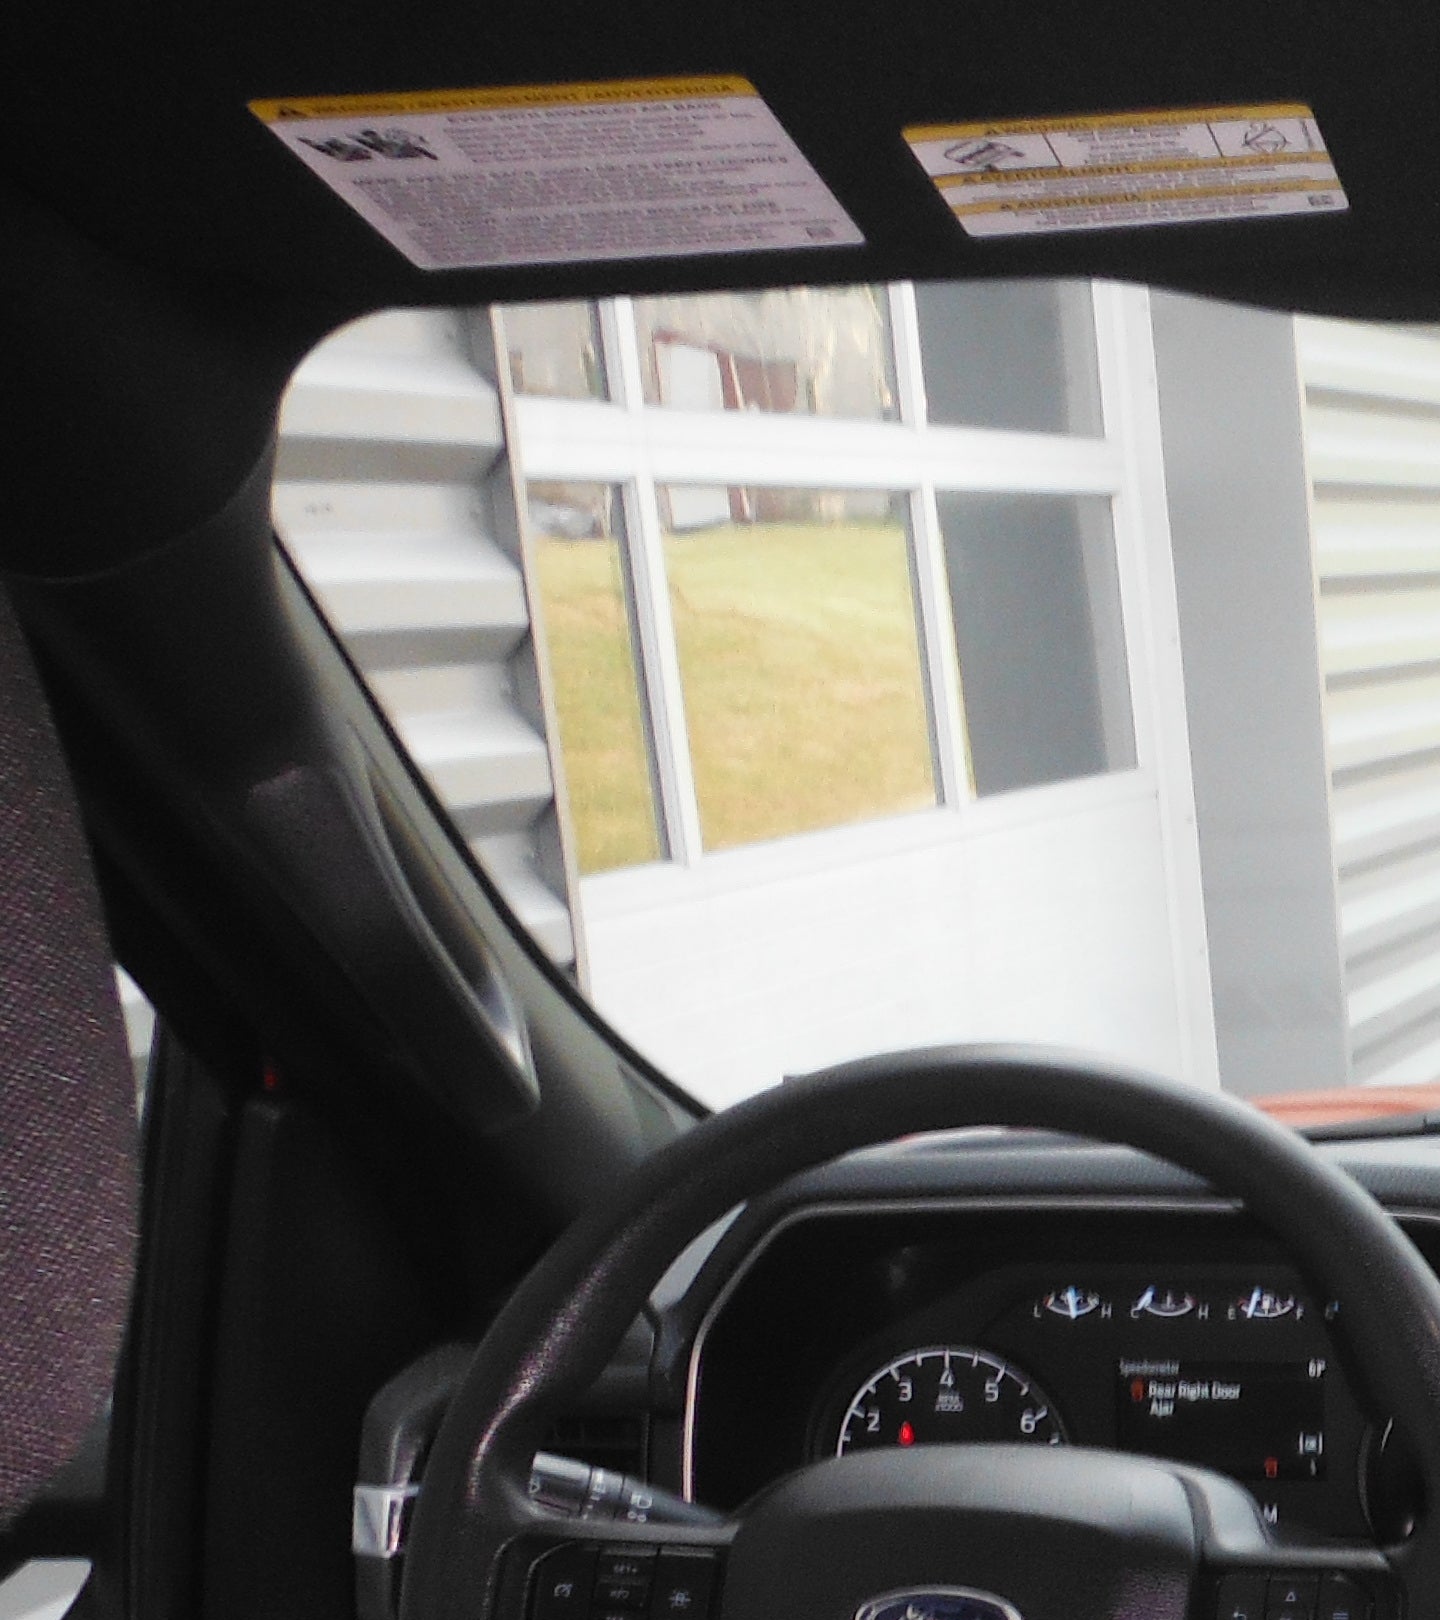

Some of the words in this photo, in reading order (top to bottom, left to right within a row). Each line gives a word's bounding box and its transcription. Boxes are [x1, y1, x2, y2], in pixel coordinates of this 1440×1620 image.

[1033, 1307, 1042, 1319] L
[1100, 1306, 1113, 1319] H
[1197, 1306, 1209, 1320] H
[1227, 1307, 1236, 1320] E
[939, 1369, 955, 1388] 4
[898, 1377, 913, 1402] 3
[984, 1378, 1000, 1403] 5
[1148, 1380, 1177, 1399] Rear
[1178, 1381, 1210, 1402] Right
[1211, 1382, 1242, 1401] Door
[1149, 1400, 1175, 1417] Ajar
[866, 1409, 881, 1432] 2
[1020, 1409, 1036, 1434] 6
